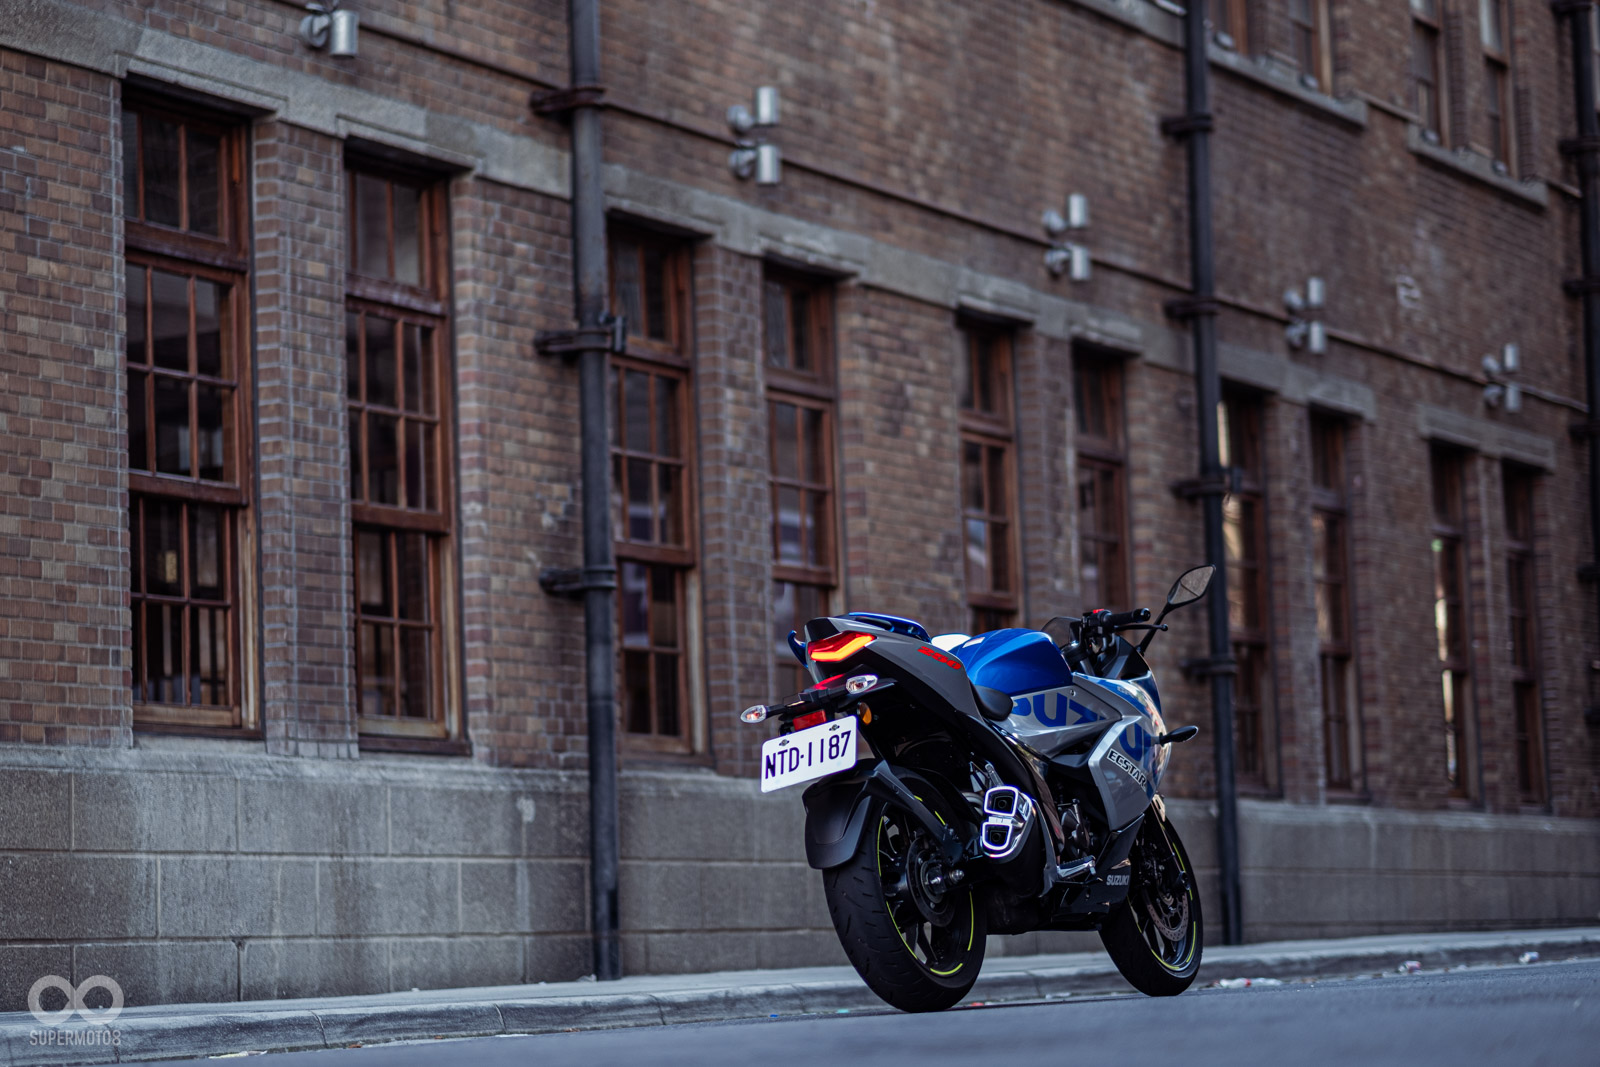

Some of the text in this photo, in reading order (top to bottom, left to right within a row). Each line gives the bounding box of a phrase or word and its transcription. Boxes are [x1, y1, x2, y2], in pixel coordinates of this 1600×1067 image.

[917, 646, 961, 670] 250
[1107, 749, 1147, 790] ECSTAR
[1106, 874, 1130, 886] SUZUKI
